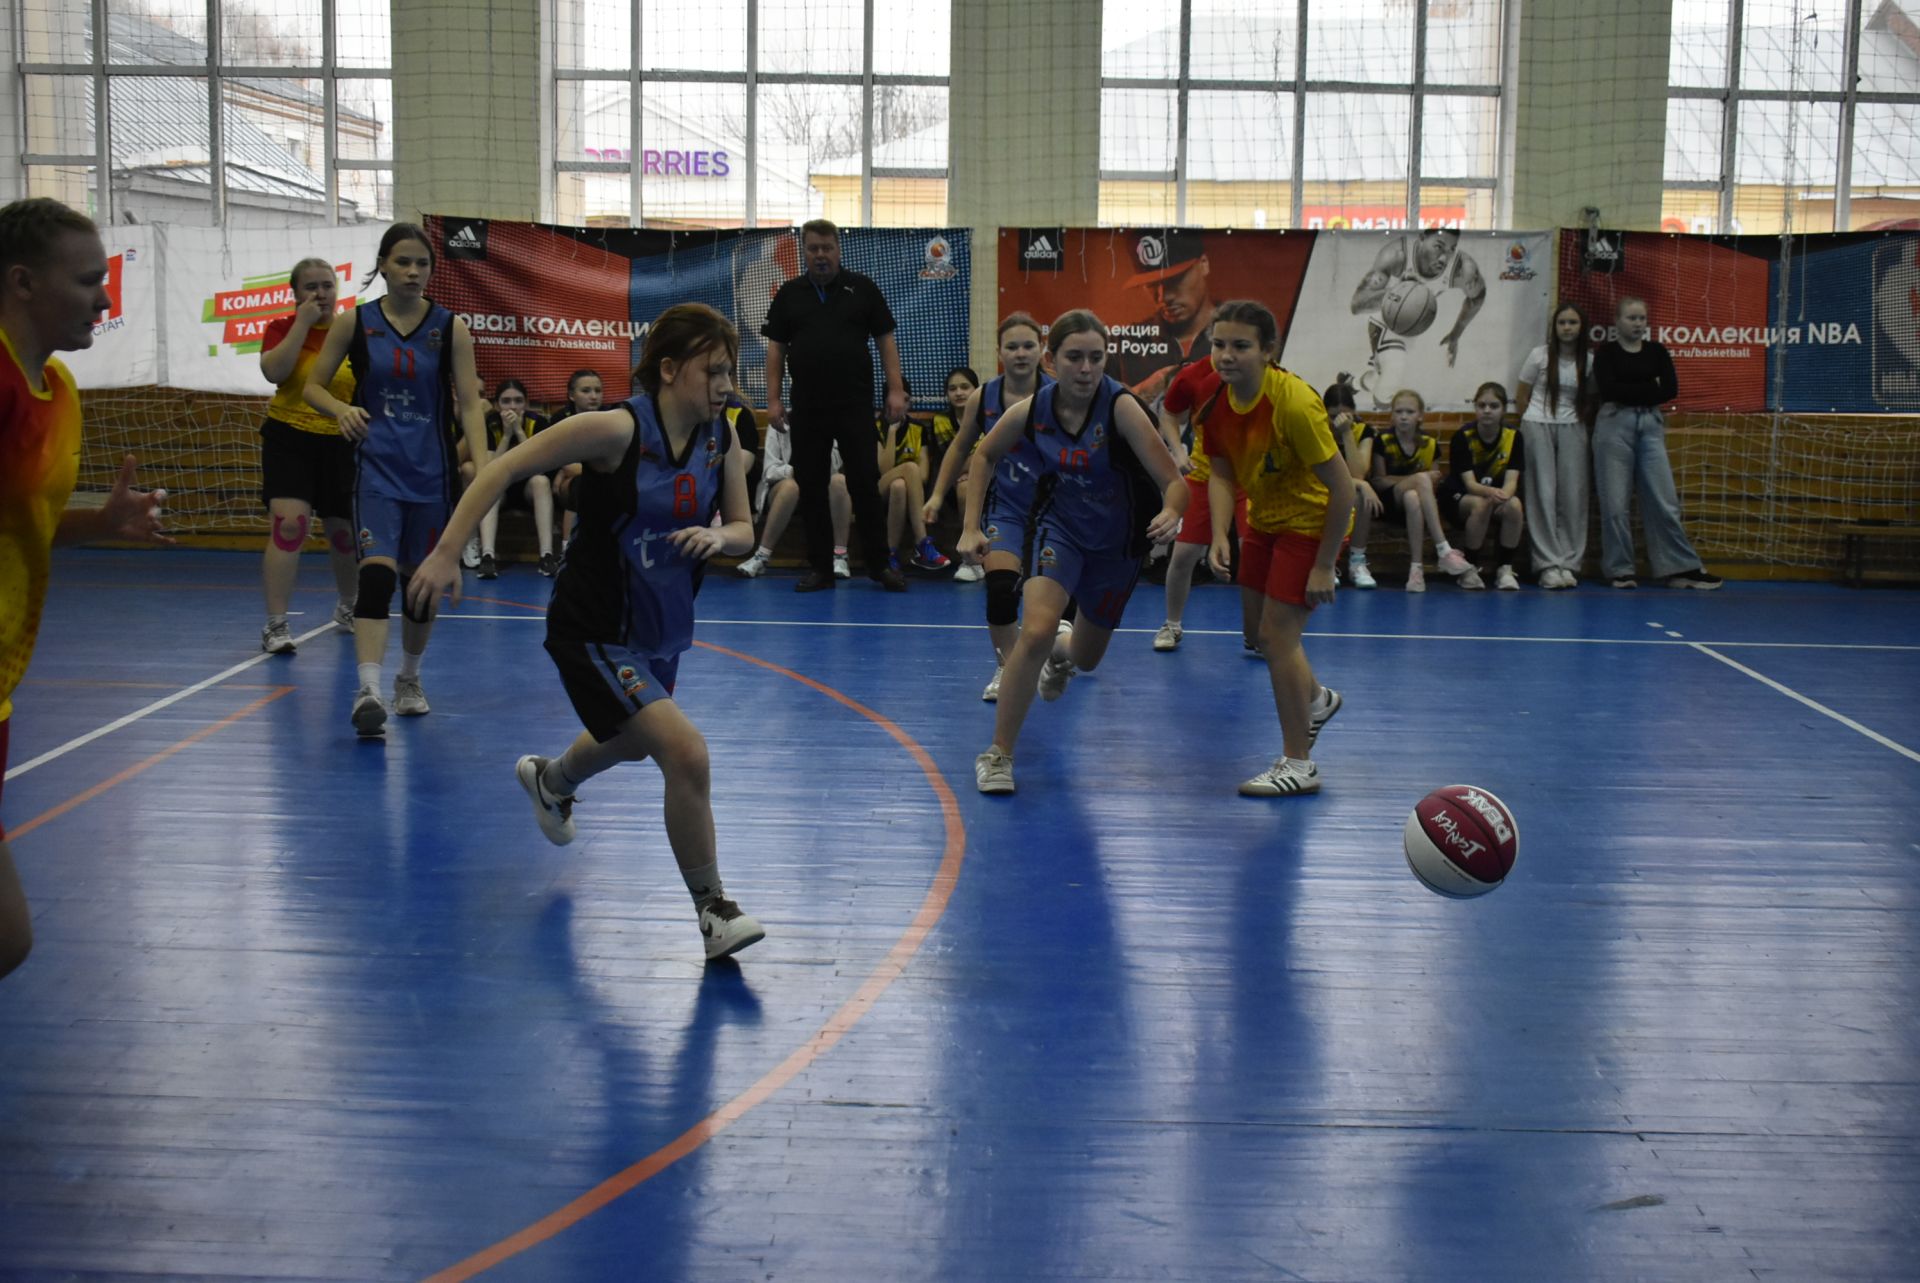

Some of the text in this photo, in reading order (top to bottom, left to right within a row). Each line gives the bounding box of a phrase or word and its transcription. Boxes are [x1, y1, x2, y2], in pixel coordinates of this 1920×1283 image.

[448, 239, 481, 249] adidas
[1024, 250, 1057, 259] adidas
[222, 287, 296, 311] КОМАНД
[92, 317, 125, 337] СТАН
[460, 312, 650, 341] овая коллекци
[1658, 326, 1800, 347] коллекция
[1807, 322, 1862, 345] NBA
[479, 336, 616, 350] www.adidas.ru/basketball
[1121, 340, 1168, 357] Роуза
[1669, 347, 1750, 358] s.ru/basketball
[394, 348, 415, 378] 11
[1059, 447, 1089, 473] 10
[673, 473, 698, 519] 8
[1456, 788, 1513, 845] PEAK
